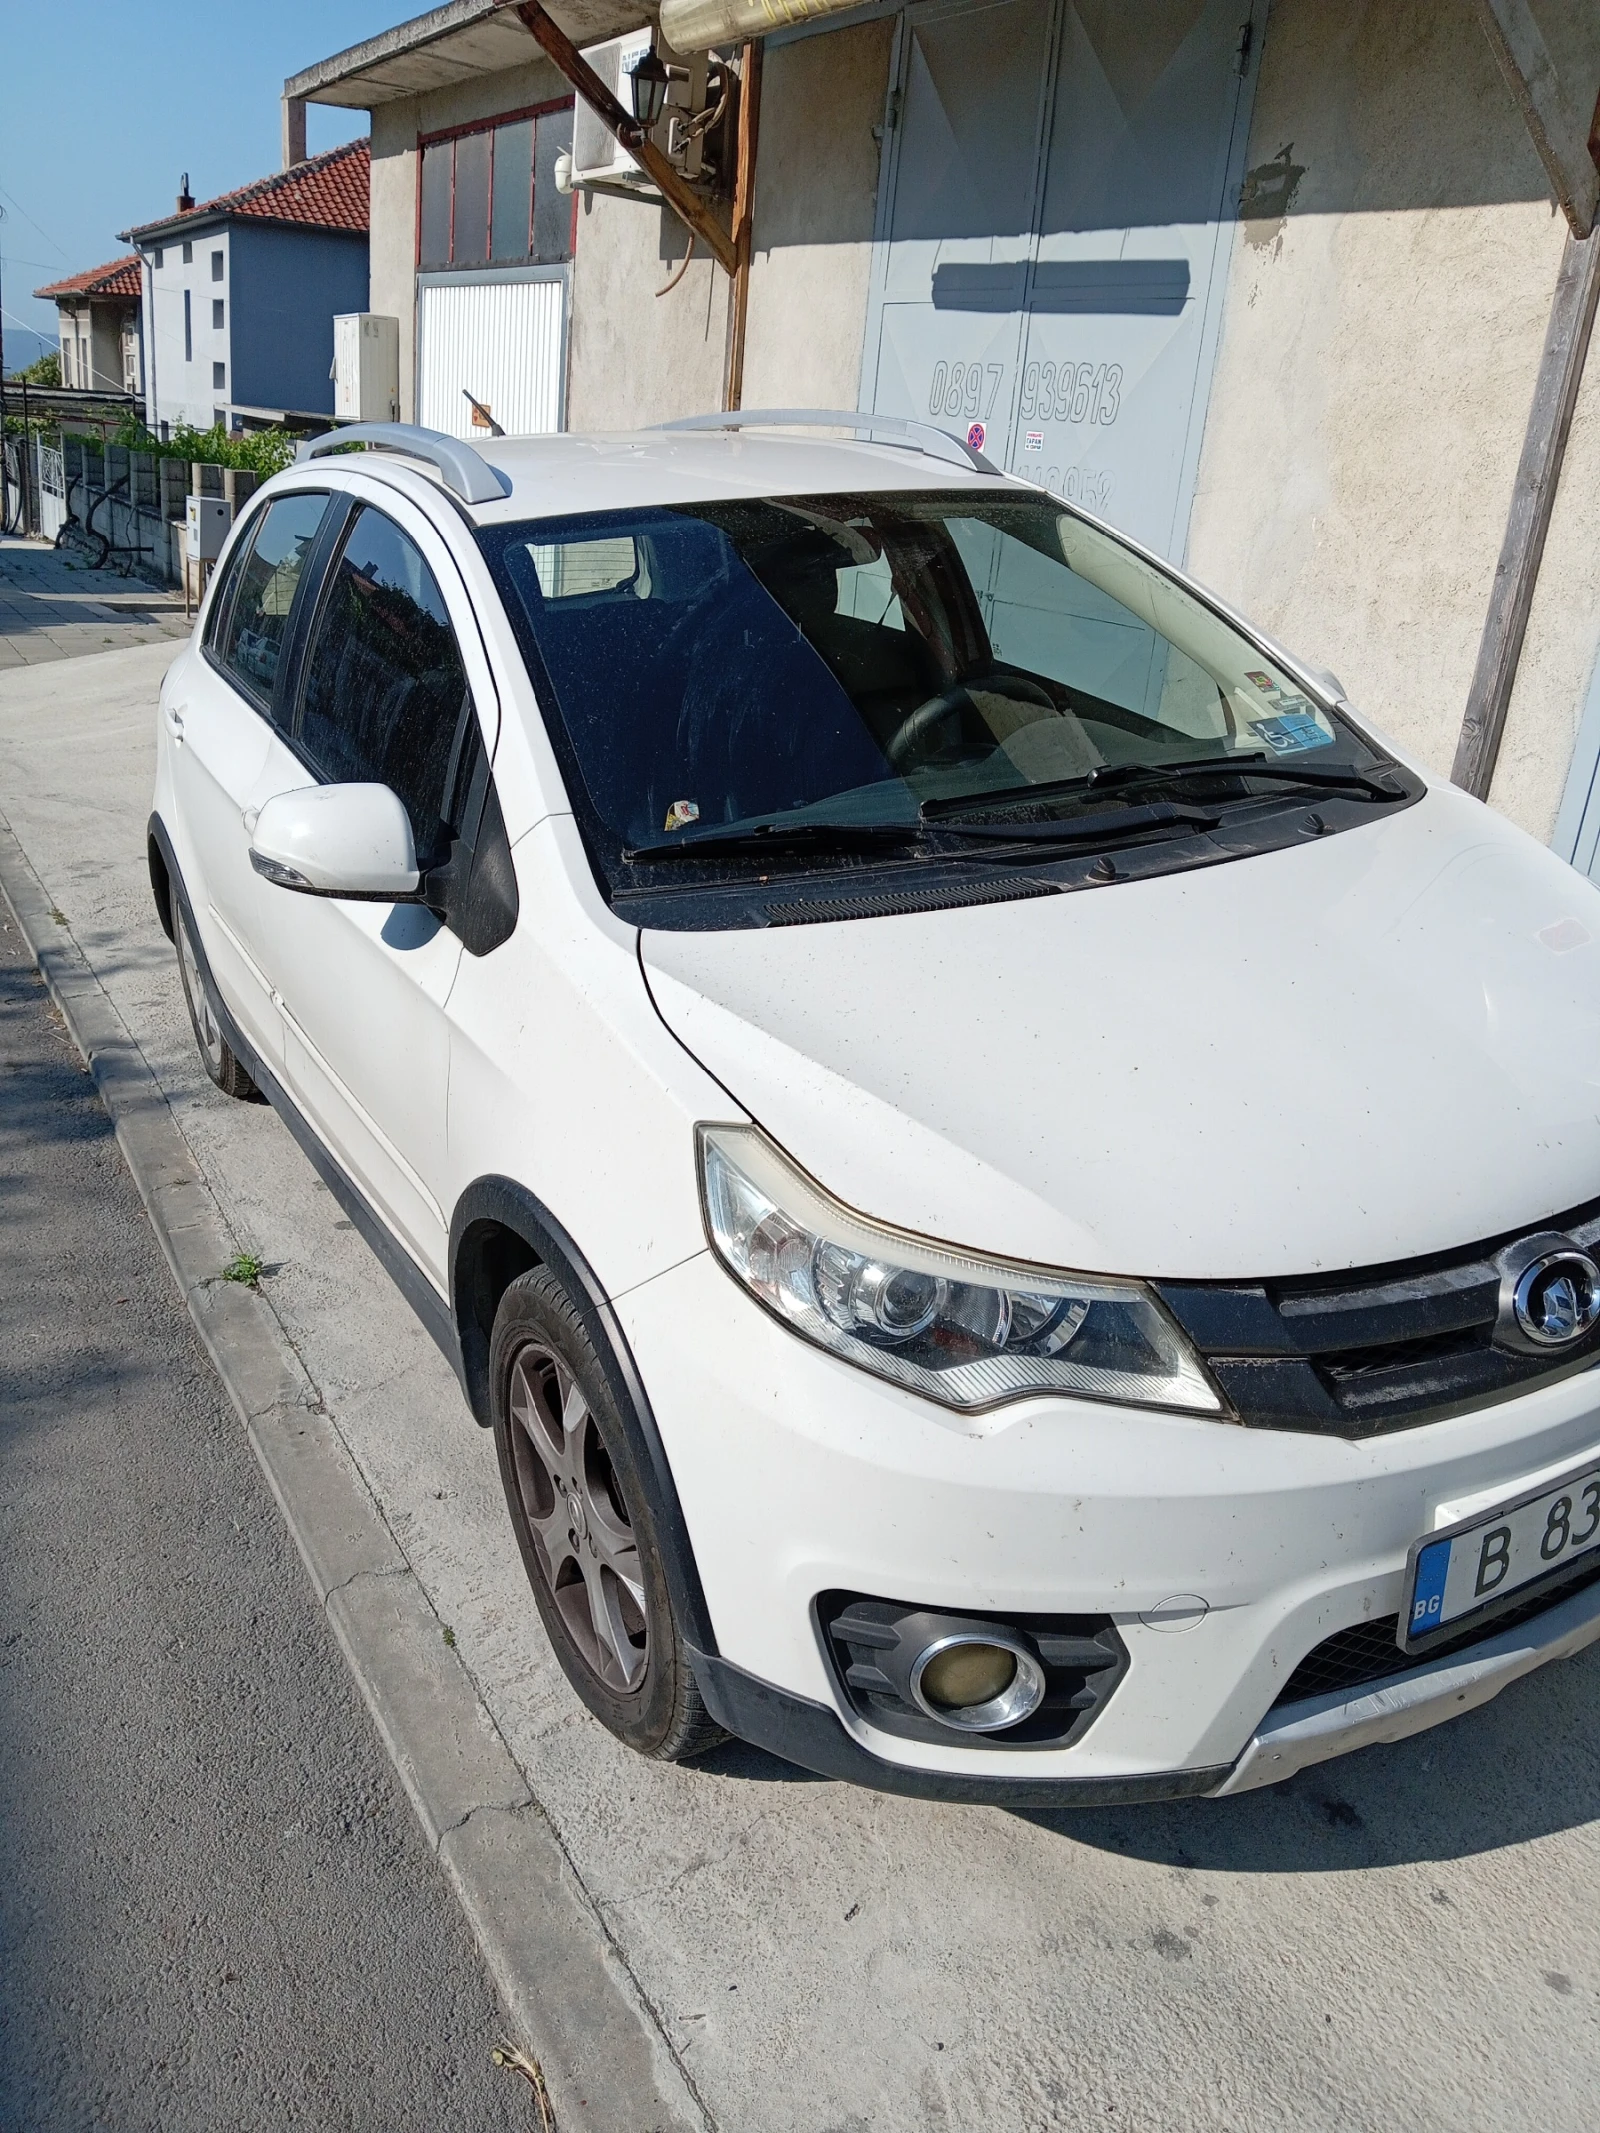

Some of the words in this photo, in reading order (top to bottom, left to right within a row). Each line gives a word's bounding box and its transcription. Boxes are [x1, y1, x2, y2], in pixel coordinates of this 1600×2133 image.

[929, 360, 1004, 420] 0897
[1020, 360, 1124, 426] 939613
[1474, 1526, 1512, 1598] B
[1413, 1595, 1440, 1620] BG
